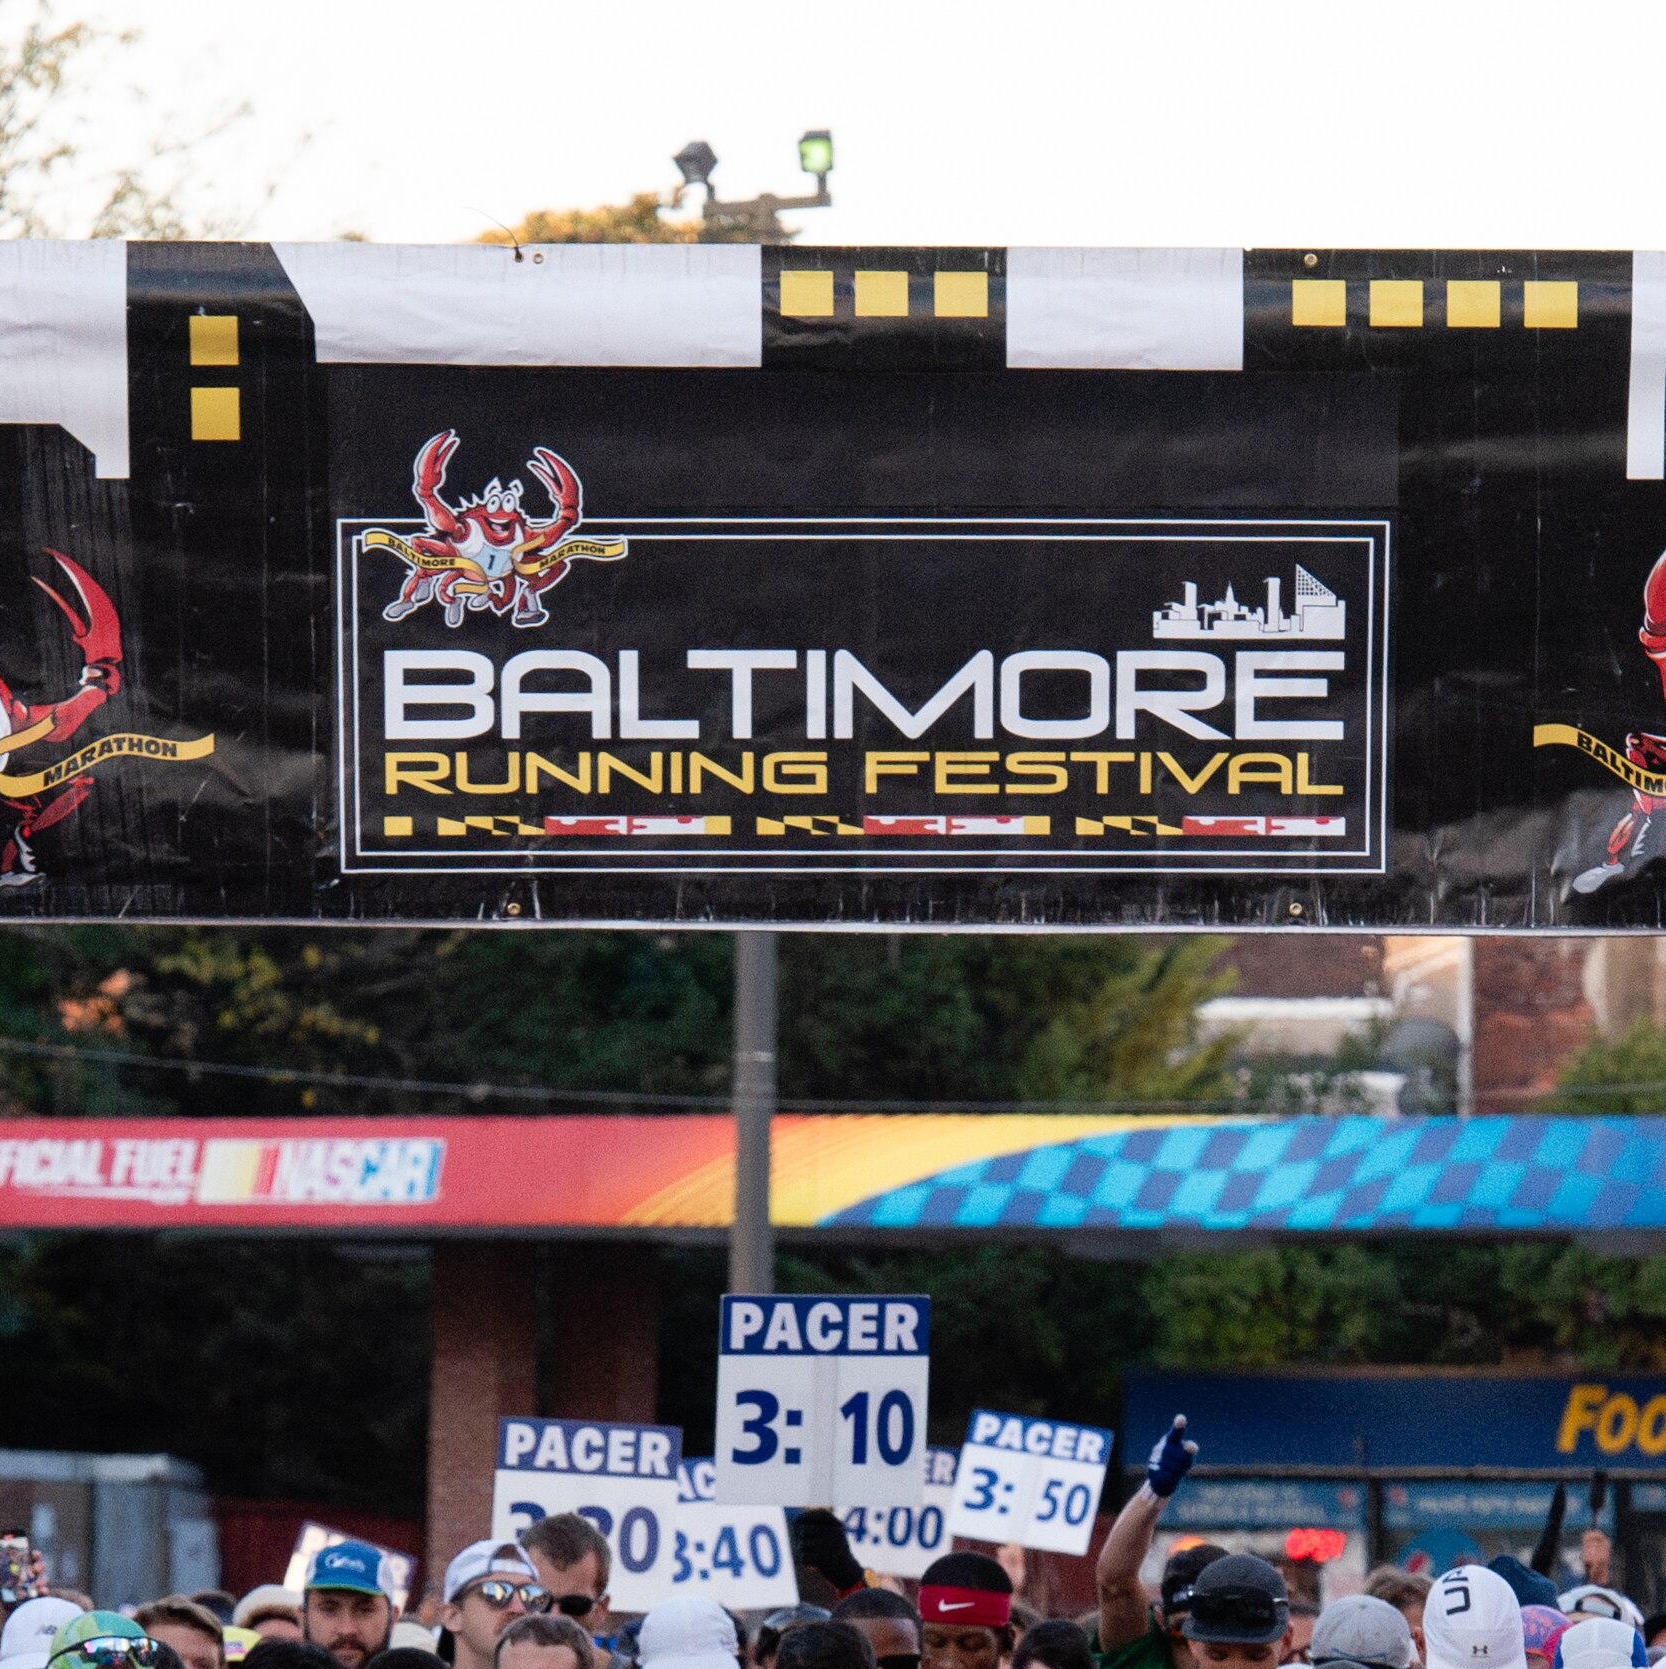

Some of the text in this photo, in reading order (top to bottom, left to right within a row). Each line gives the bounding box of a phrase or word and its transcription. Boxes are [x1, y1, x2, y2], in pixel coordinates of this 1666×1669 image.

[384, 649, 1345, 740] BALTIMORE
[42, 736, 178, 788] MARATHON
[384, 751, 1345, 795] RUNNING FESTIVAL
[109, 1137, 199, 1188] FUEL
[729, 1302, 920, 1352] PACER
[504, 1422, 674, 1477] PACER
[972, 1418, 1105, 1464] PACER
